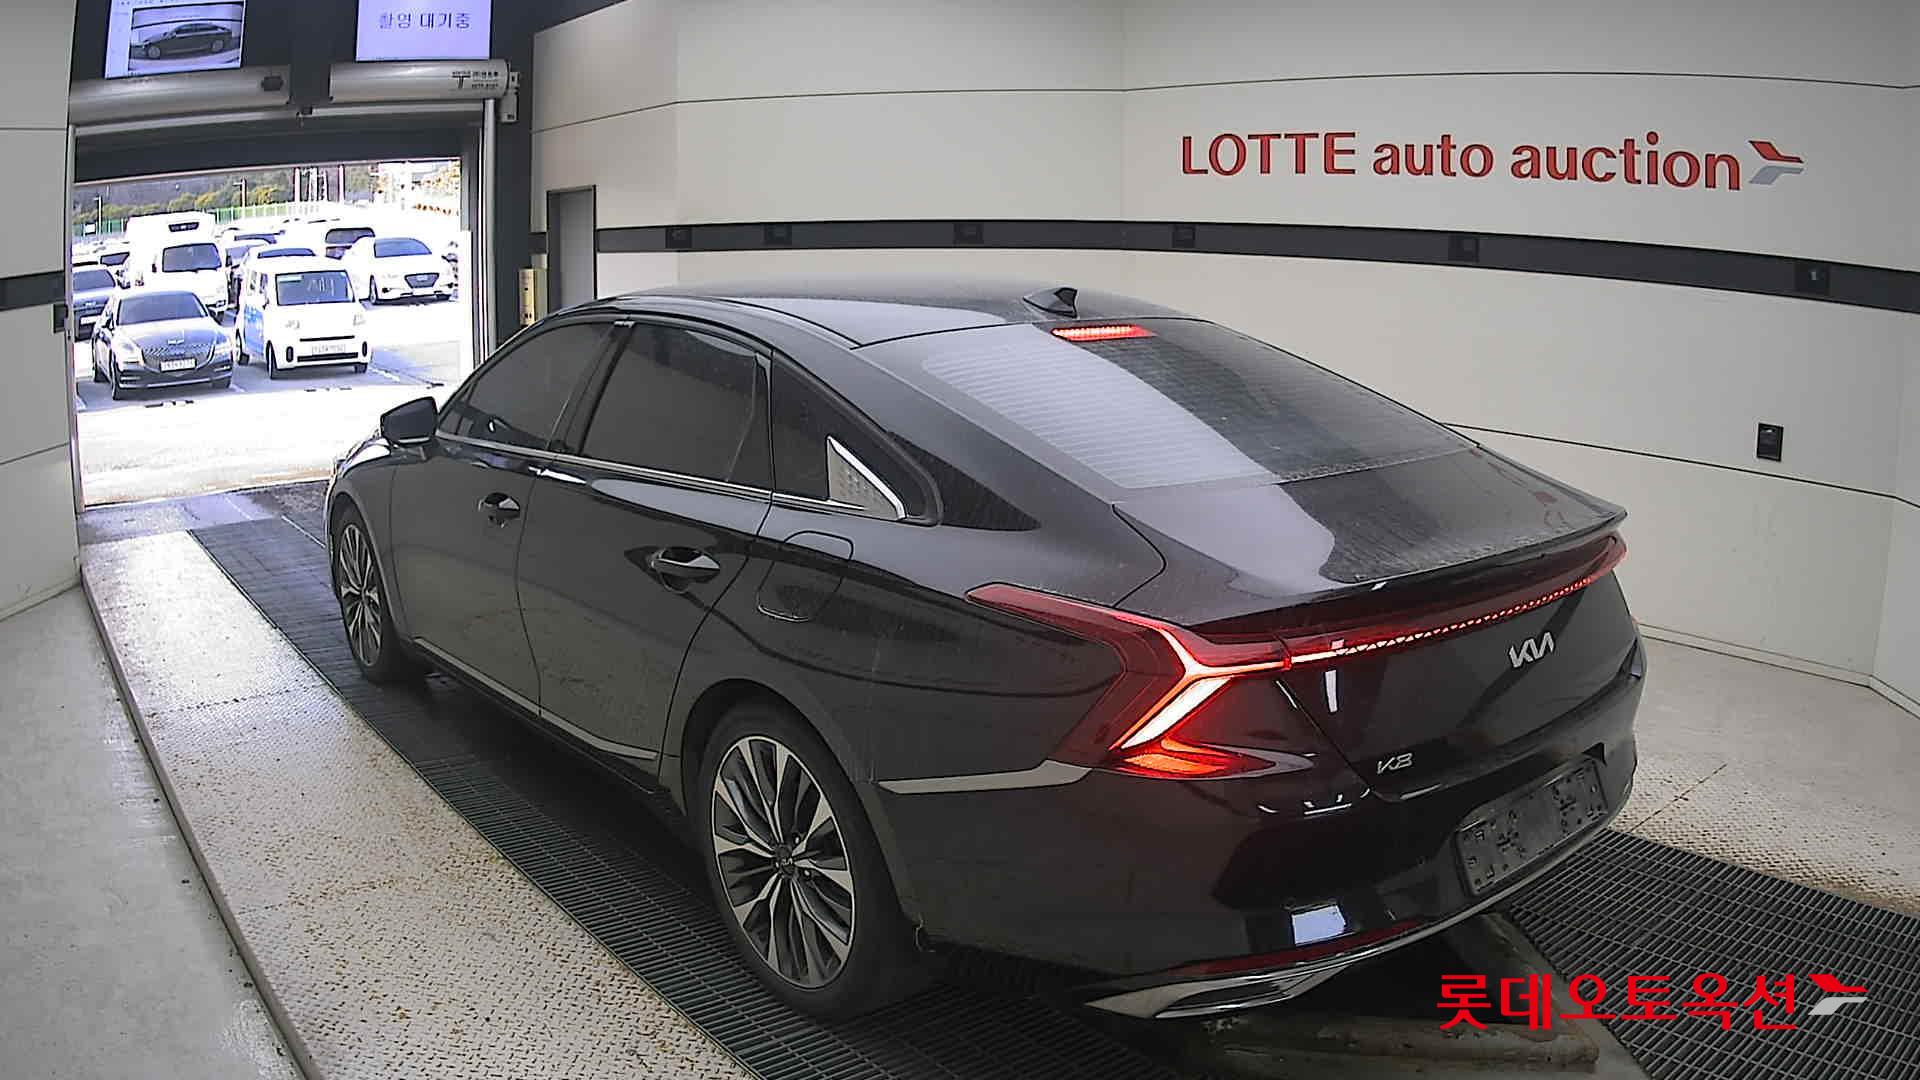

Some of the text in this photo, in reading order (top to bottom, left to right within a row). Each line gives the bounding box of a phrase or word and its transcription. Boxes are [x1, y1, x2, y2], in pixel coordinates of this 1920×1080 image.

[420, 12, 471, 29] 대기중
[1182, 131, 1741, 191] LOTTE auto auction
[1376, 752, 1413, 775] K8
